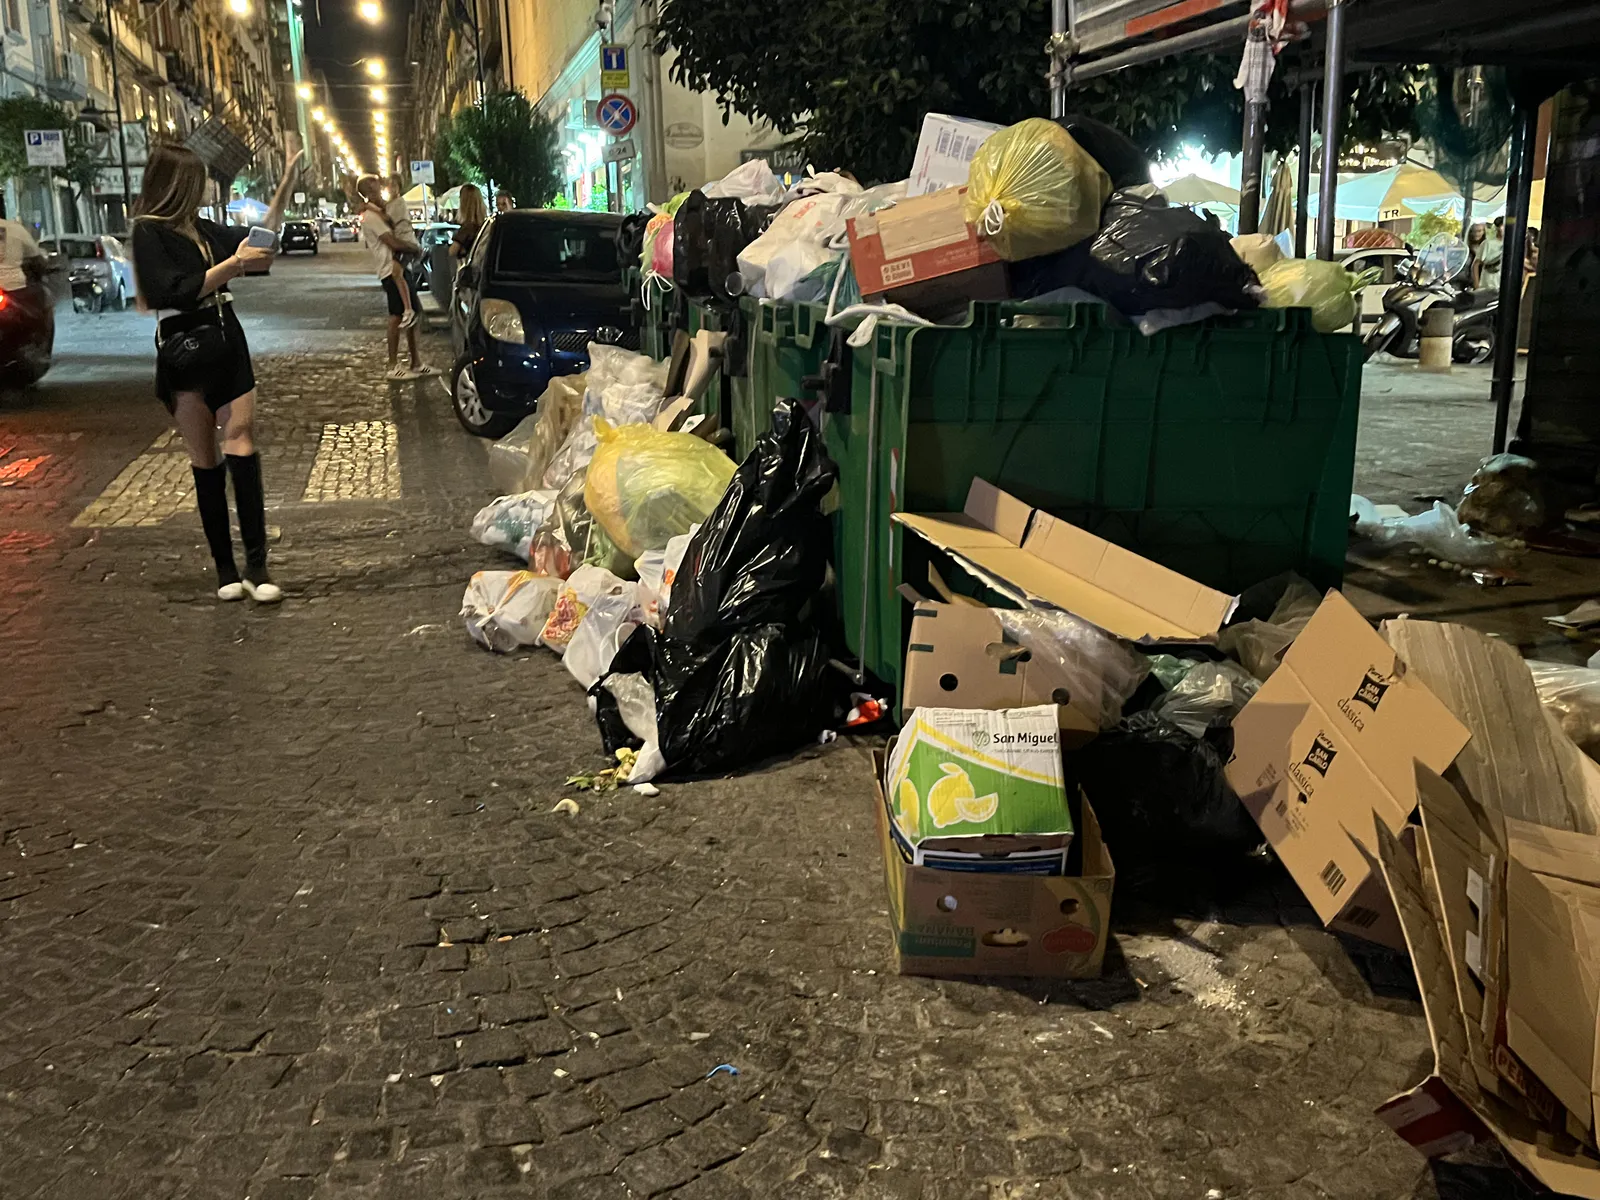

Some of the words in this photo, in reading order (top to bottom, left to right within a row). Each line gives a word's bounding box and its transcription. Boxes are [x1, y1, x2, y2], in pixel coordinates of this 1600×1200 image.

[30, 132, 39, 145] P
[1383, 209, 1399, 219] TR
[1358, 688, 1379, 704] CARLO
[1365, 683, 1380, 695] SAN
[1337, 697, 1365, 733] classica
[993, 733, 1015, 744] San
[1017, 731, 1059, 747] Miguel
[1308, 753, 1328, 769] CARLO
[1315, 748, 1329, 761] SAN
[1288, 761, 1315, 797] classica
